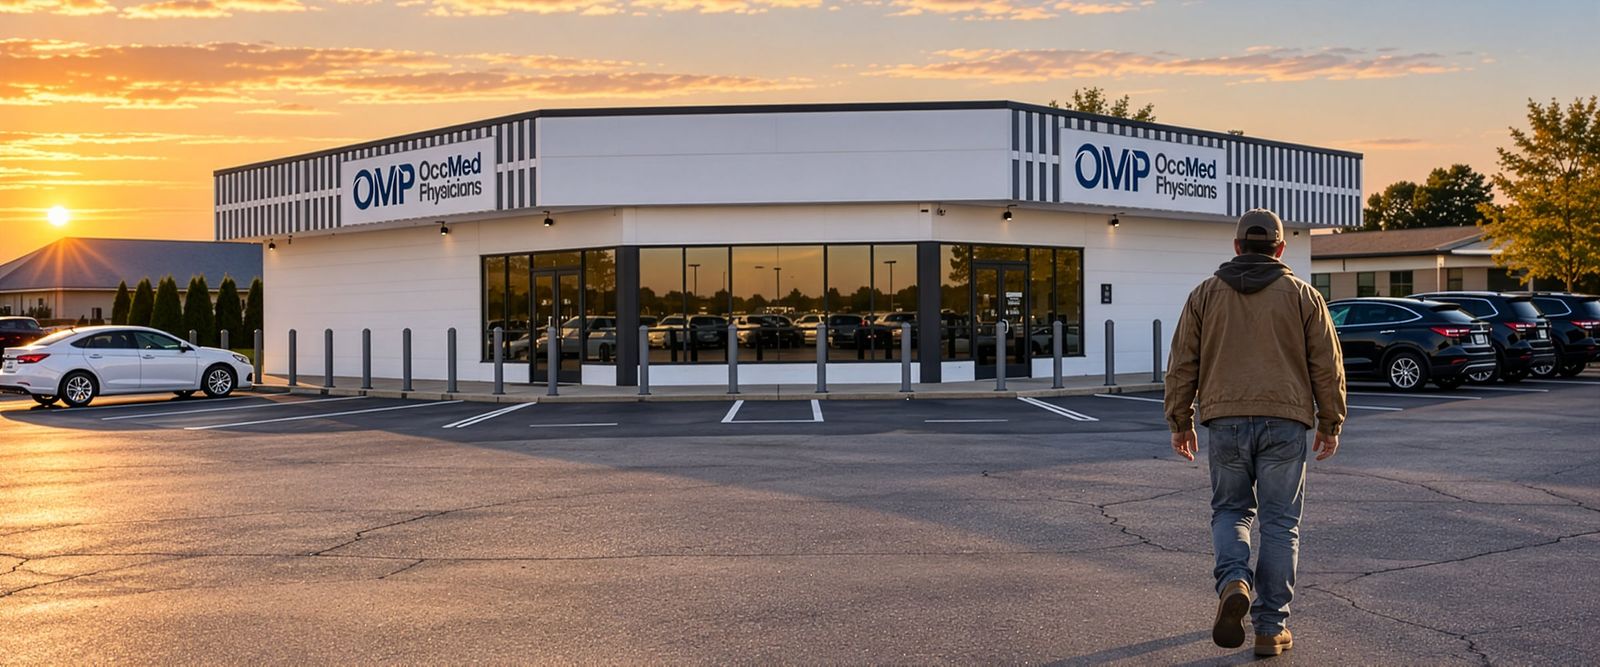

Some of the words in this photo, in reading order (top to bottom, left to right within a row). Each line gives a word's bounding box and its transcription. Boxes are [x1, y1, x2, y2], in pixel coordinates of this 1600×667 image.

[419, 152, 481, 181] OccMed
[1075, 143, 1150, 192] OMP
[1155, 153, 1216, 179] OccMed
[354, 164, 415, 209] OMP
